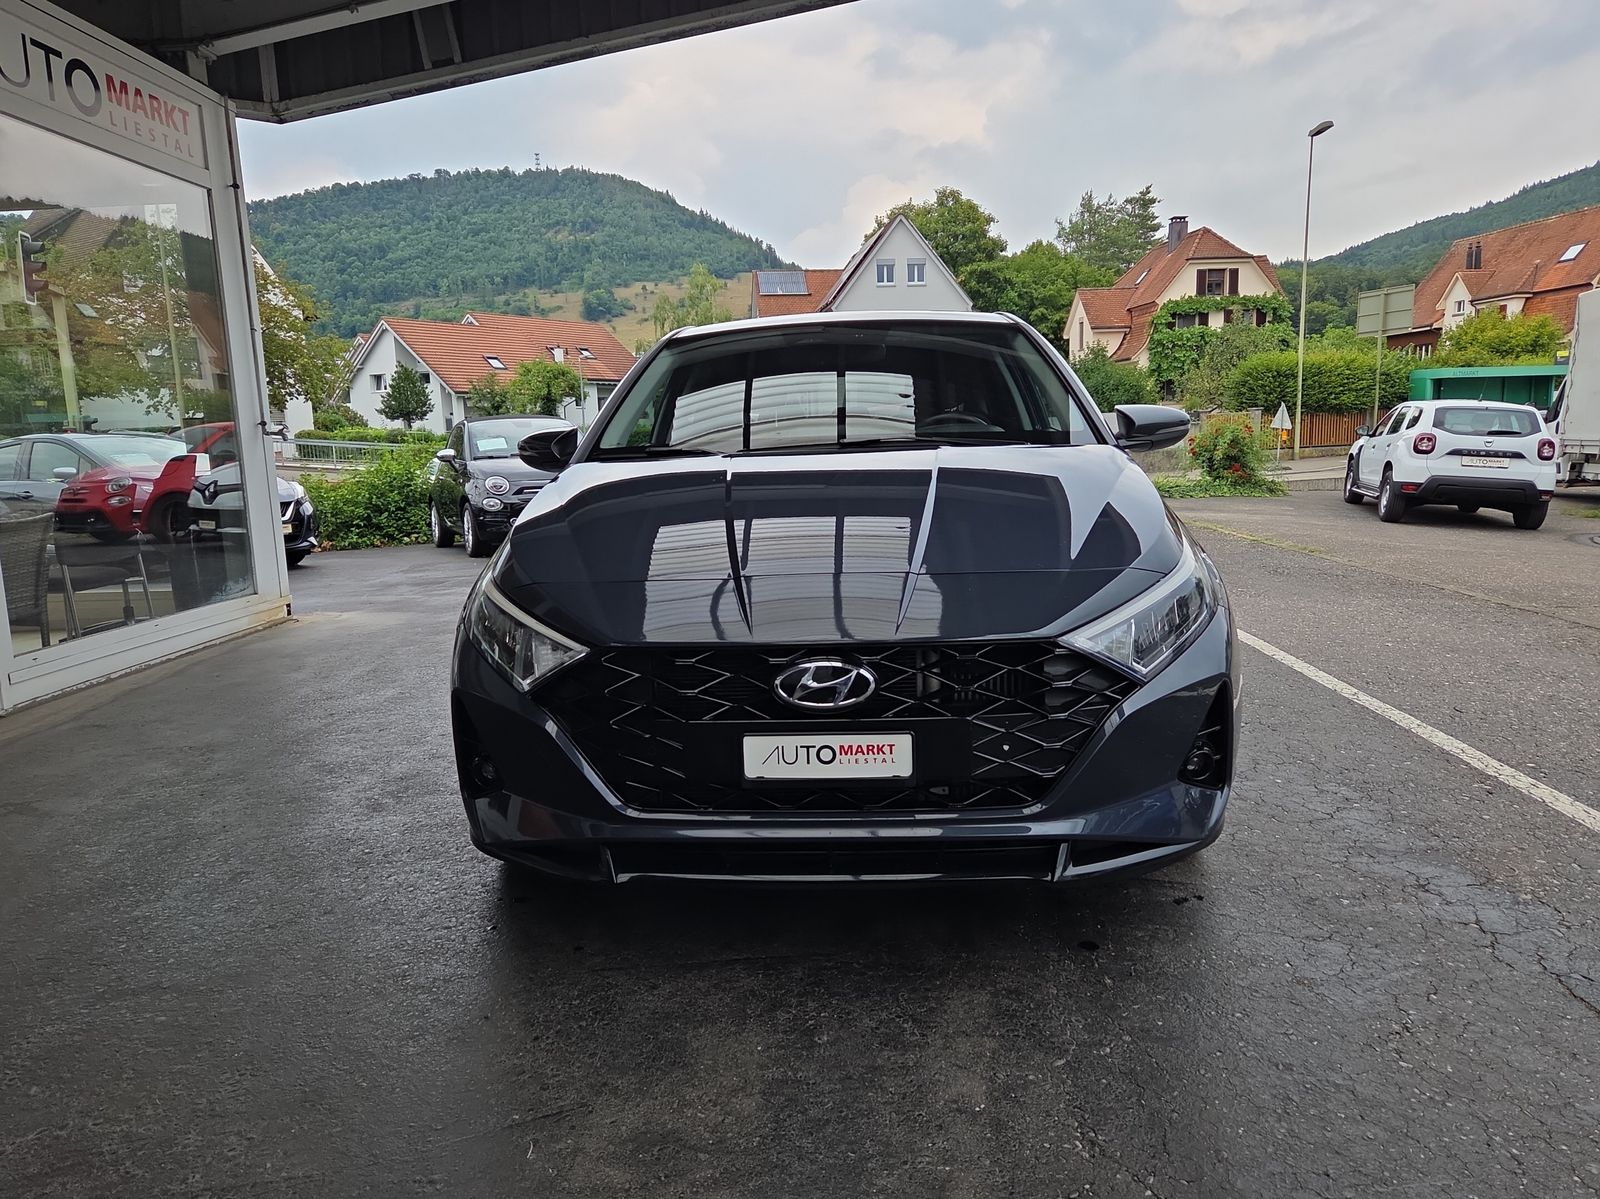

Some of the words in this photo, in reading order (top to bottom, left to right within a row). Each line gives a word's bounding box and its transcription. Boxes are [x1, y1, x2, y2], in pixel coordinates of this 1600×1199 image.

[105, 73, 190, 136] MARKT
[108, 110, 195, 158] LIESTAL
[839, 743, 896, 756] MARKT
[839, 757, 897, 765] LIESTAL
